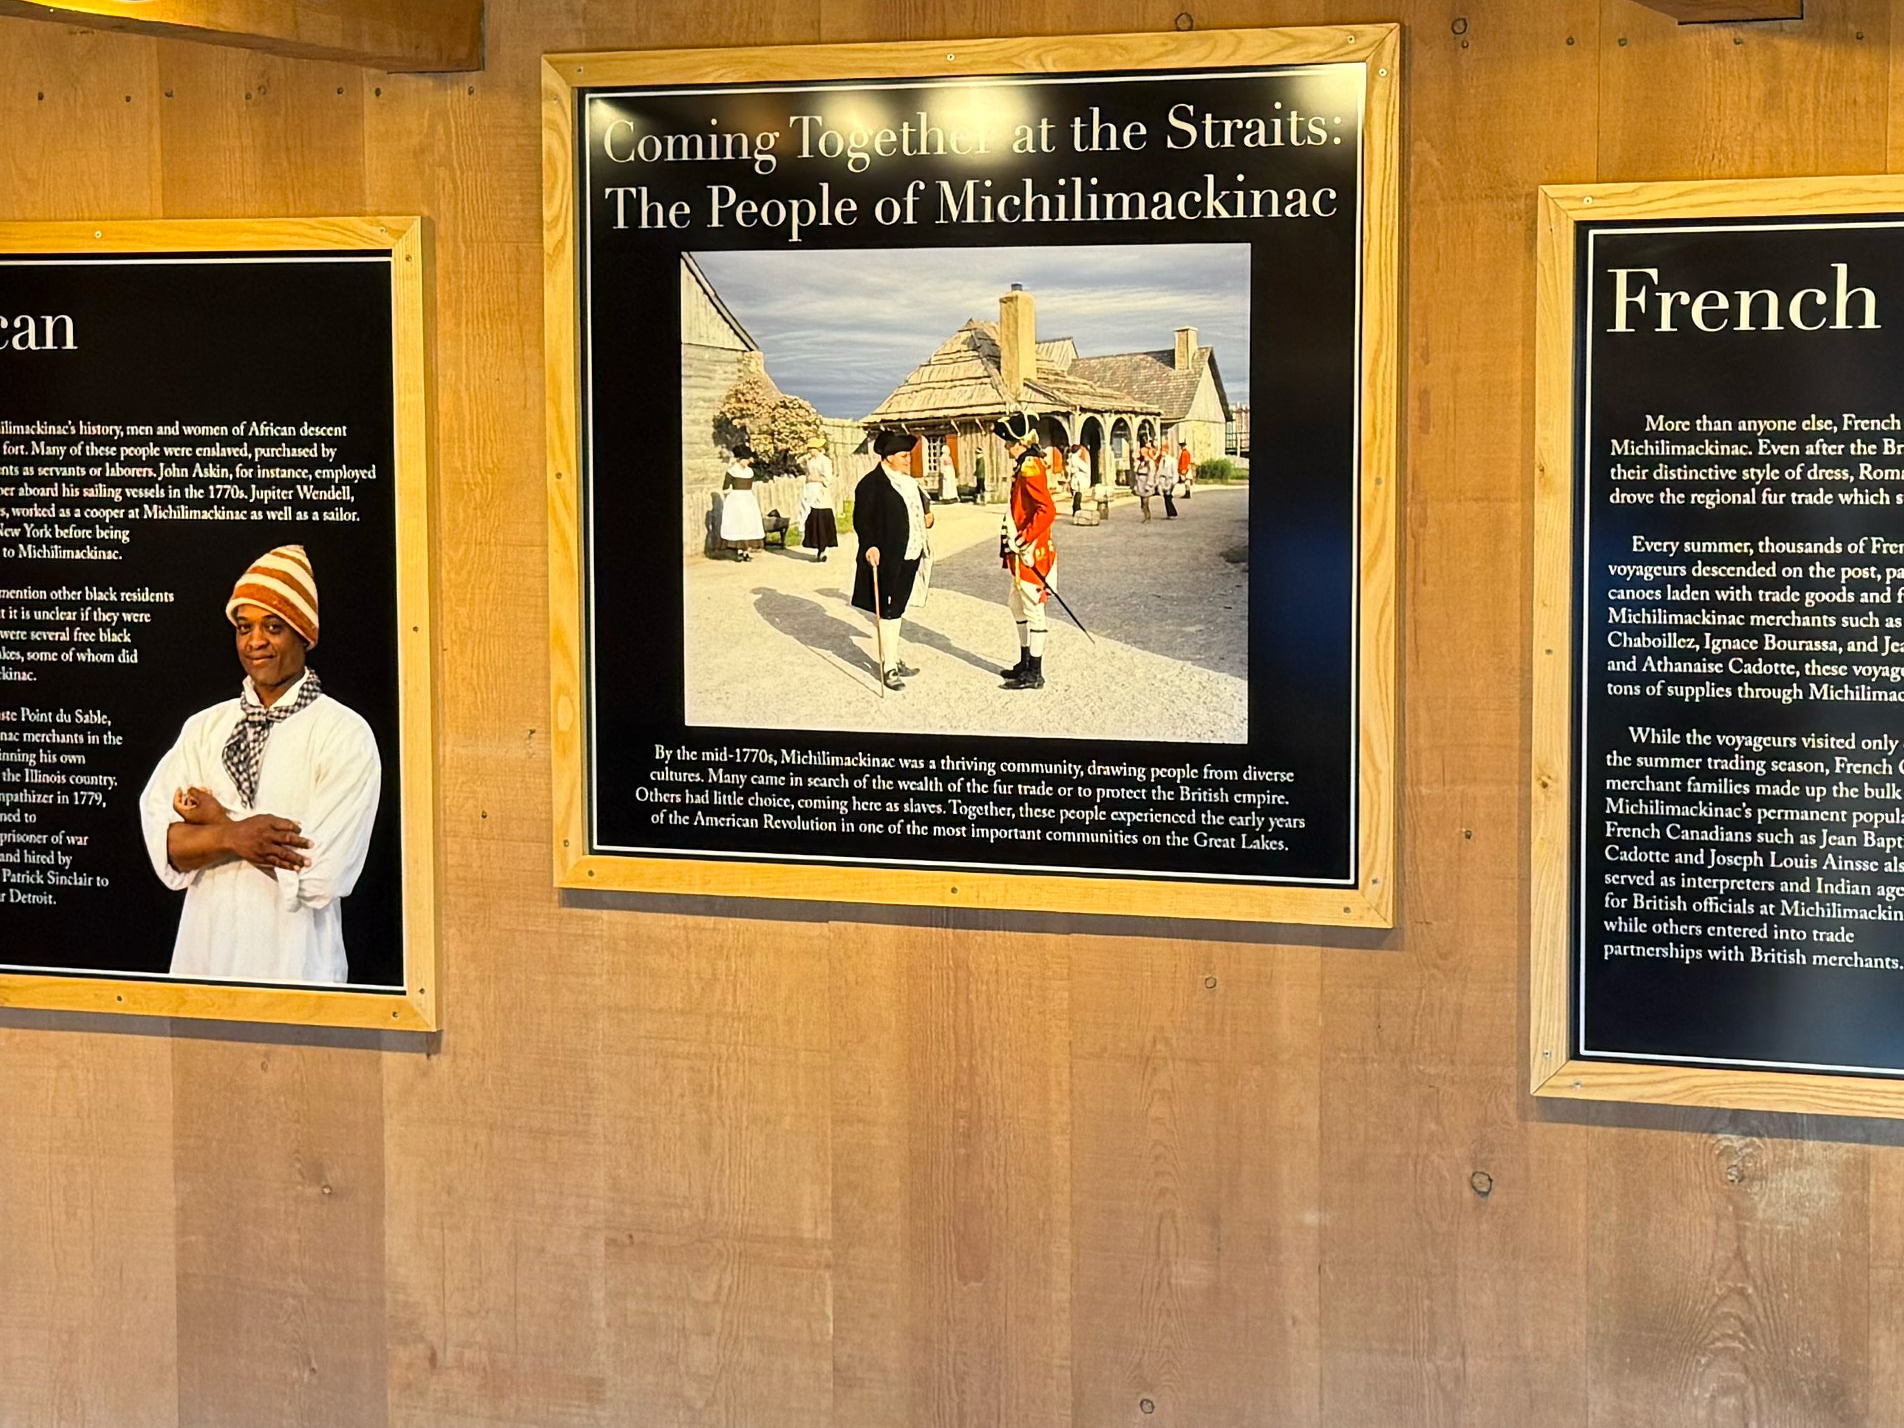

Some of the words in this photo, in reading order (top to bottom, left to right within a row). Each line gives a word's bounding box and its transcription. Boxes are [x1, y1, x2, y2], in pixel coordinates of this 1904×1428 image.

[603, 118, 780, 175] Coming
[1012, 116, 1055, 155] at
[1070, 106, 1148, 152] the
[1166, 102, 1343, 150] Straits:
[604, 186, 691, 230] The
[706, 182, 858, 242] People
[874, 179, 926, 226] of
[934, 173, 1337, 224] Michilimackinac
[1606, 262, 1882, 333] French
[79, 420, 124, 440] history,
[126, 425, 154, 436] men
[156, 420, 180, 436] and
[182, 425, 229, 437] women
[231, 421, 247, 436] of
[248, 421, 296, 436] African
[299, 421, 347, 437] descent
[1645, 414, 1690, 432] More
[1696, 414, 1732, 432] than
[1738, 418, 1796, 437] anyone
[1801, 413, 1838, 434] else,
[1841, 412, 1903, 432] French
[1607, 683, 1641, 697] tons
[1645, 681, 1666, 696] of
[1667, 682, 1732, 703] supplies
[1737, 682, 1803, 704] through
[20, 706, 53, 723] Point
[55, 708, 72, 724] du
[74, 708, 112, 727] Sable,
[654, 743, 673, 765] By
[676, 745, 698, 761] the
[701, 746, 778, 770] mid-1770s,
[780, 748, 896, 768] Michilimackinac
[898, 757, 925, 769] was
[928, 759, 937, 770] a
[940, 754, 997, 777] thriving
[999, 759, 1084, 780] community,
[1087, 759, 1147, 782] drawing
[1150, 763, 1199, 784] people
[1203, 763, 1239, 781] from
[1242, 764, 1295, 783] diverse
[651, 808, 668, 824] of
[668, 810, 690, 825] the
[693, 810, 759, 829] American
[763, 813, 837, 832] Revolution
[841, 817, 855, 833] in
[858, 823, 884, 834] one
[887, 818, 905, 835] of
[906, 819, 929, 836] the
[932, 825, 967, 838] most
[971, 823, 1042, 844] important
[1045, 828, 1139, 845] communities
[1142, 834, 1161, 846] on
[1165, 830, 1190, 847] the
[1193, 831, 1236, 849] Great
[1241, 833, 1289, 852] Lakes.
[1603, 941, 1703, 965] partnerships
[1707, 945, 1745, 962] with
[1750, 945, 1807, 965] British
[1812, 951, 1904, 970] merchants.
